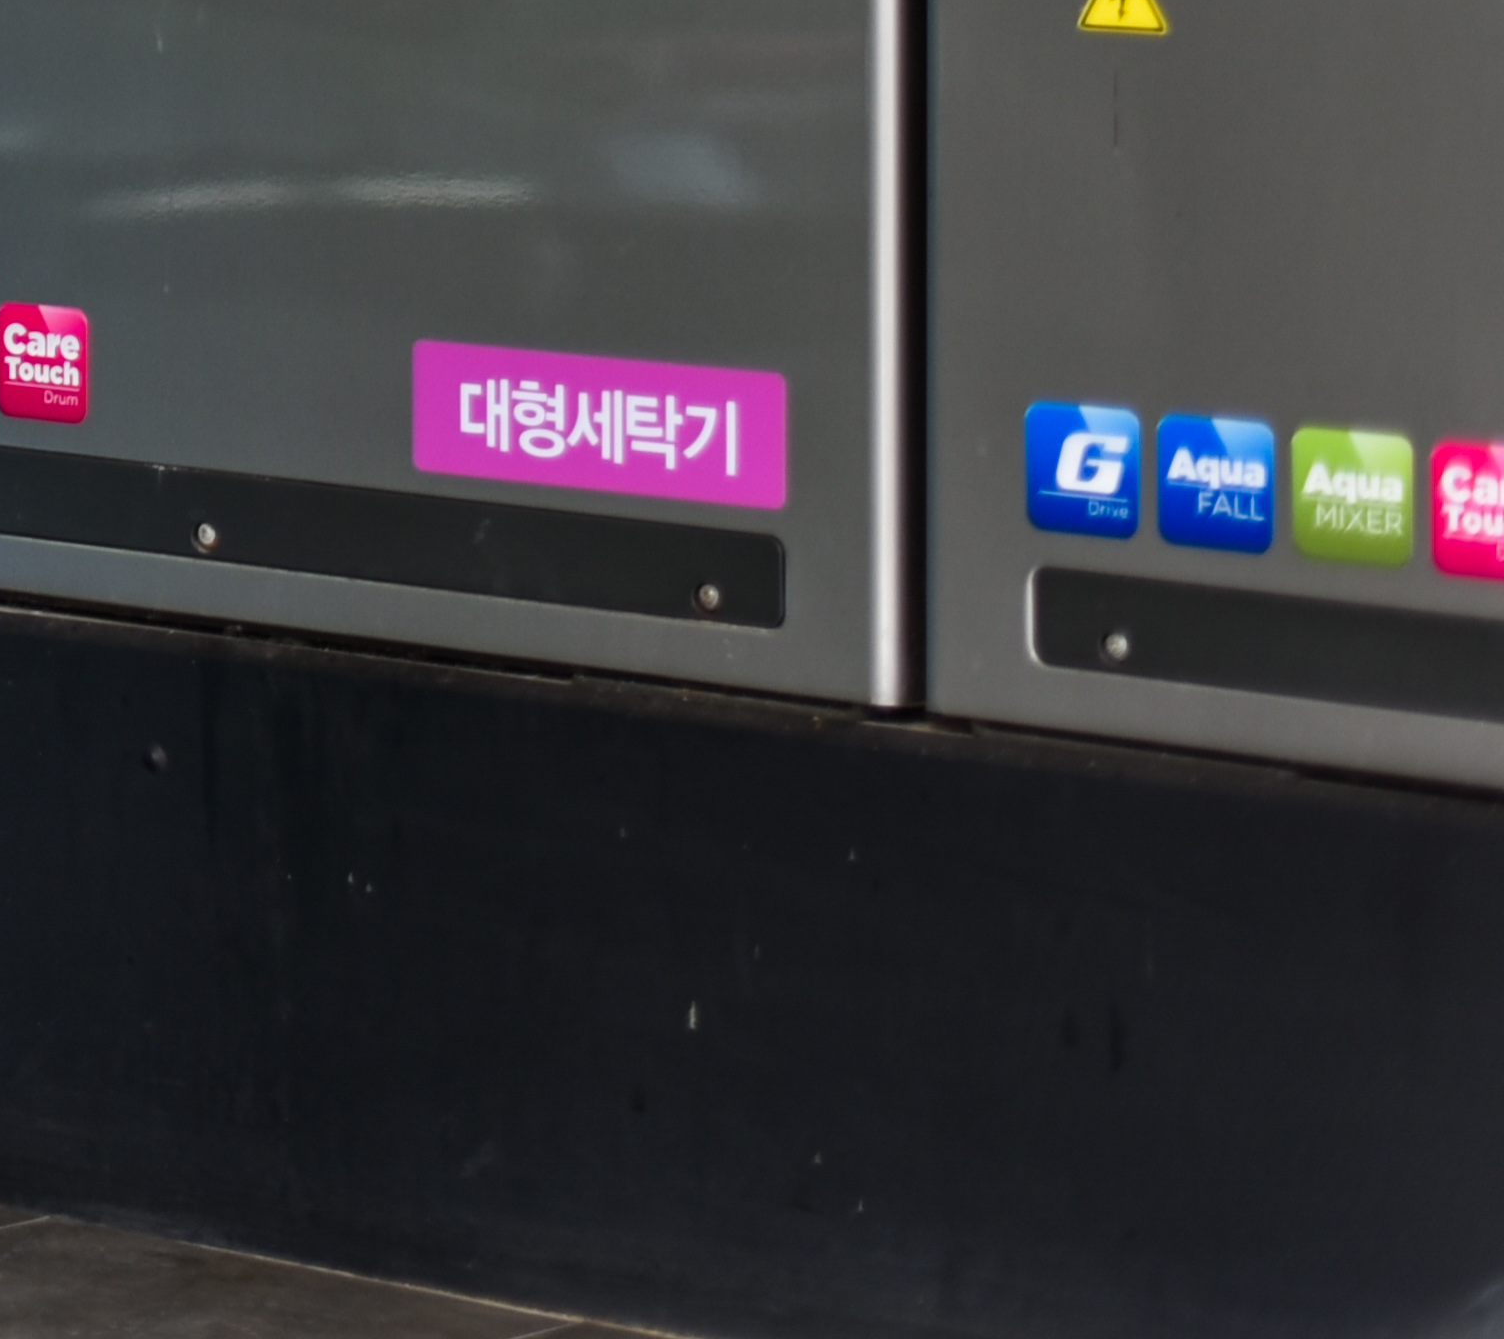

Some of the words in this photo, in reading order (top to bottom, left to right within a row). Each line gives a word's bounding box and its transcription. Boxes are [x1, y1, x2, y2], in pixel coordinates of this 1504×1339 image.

[2, 323, 81, 361] Care
[3, 356, 80, 387] Touch
[43, 389, 80, 408] Drum
[457, 377, 740, 476] 대형세탁기
[1166, 445, 1268, 497] Aqua
[1301, 460, 1405, 509] Aqua
[1196, 486, 1266, 523] FALL
[1314, 500, 1406, 538] MIXER
